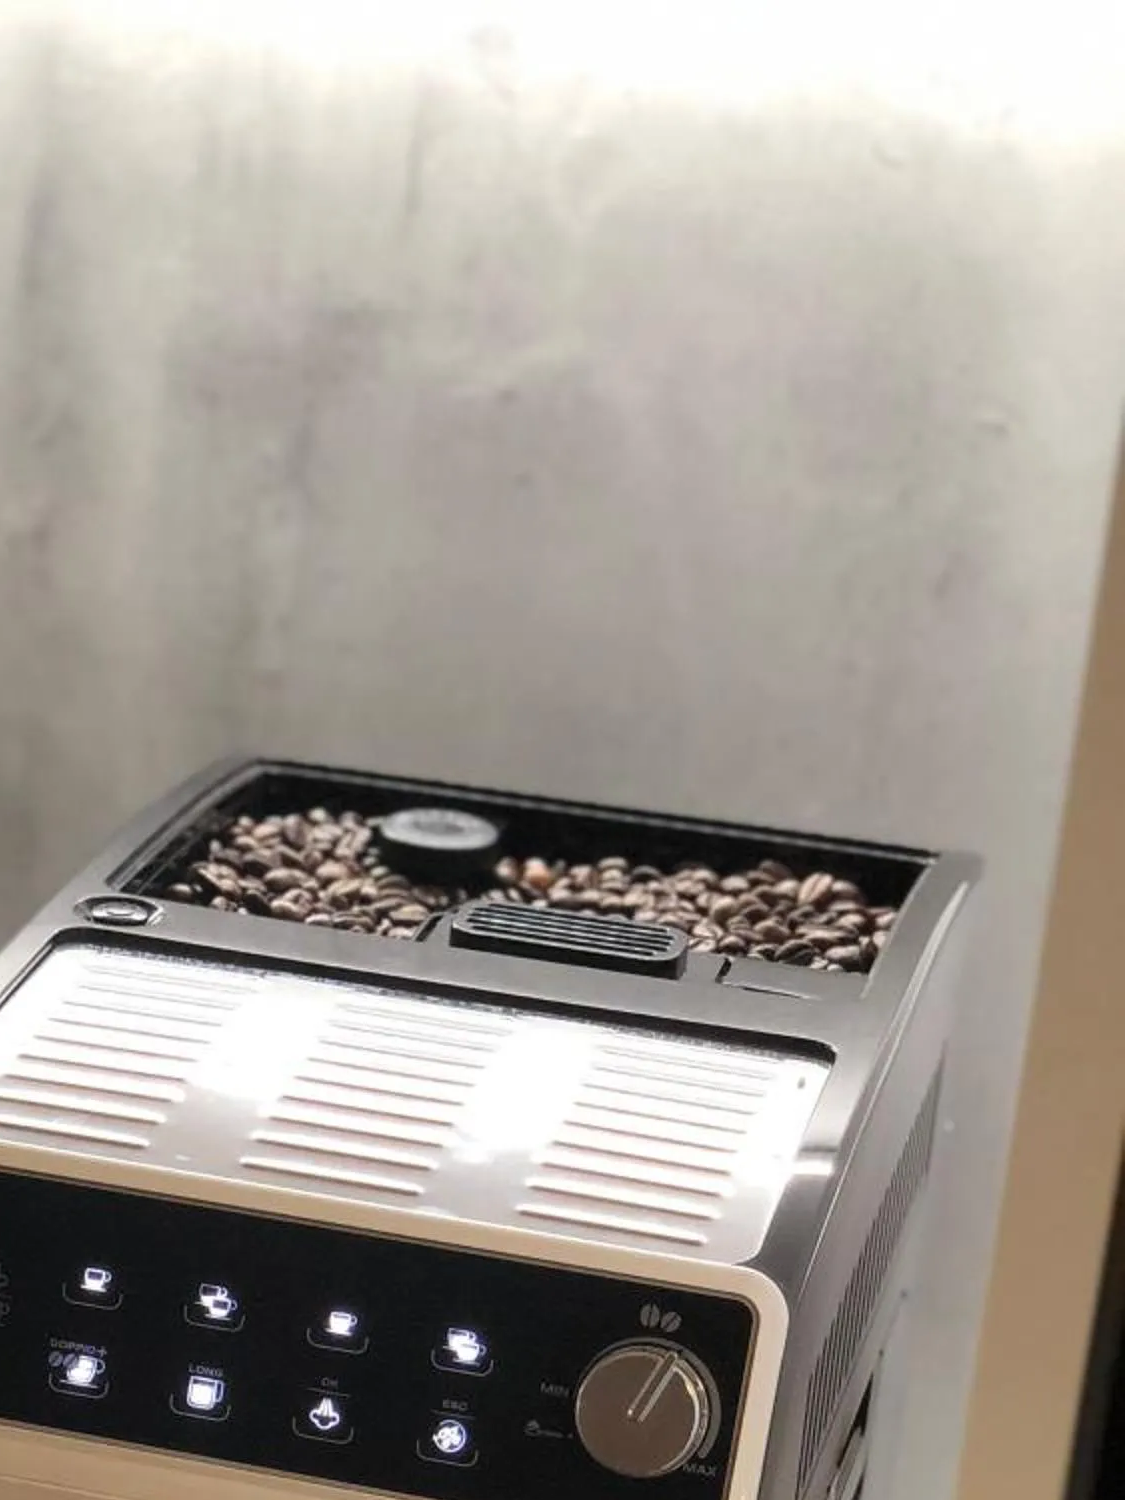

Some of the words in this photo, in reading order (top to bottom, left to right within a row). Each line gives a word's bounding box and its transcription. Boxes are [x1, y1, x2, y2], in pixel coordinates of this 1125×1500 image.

[188, 1362, 224, 1377] LONG
[540, 1382, 571, 1397] MIN
[682, 1462, 717, 1477] MAX
